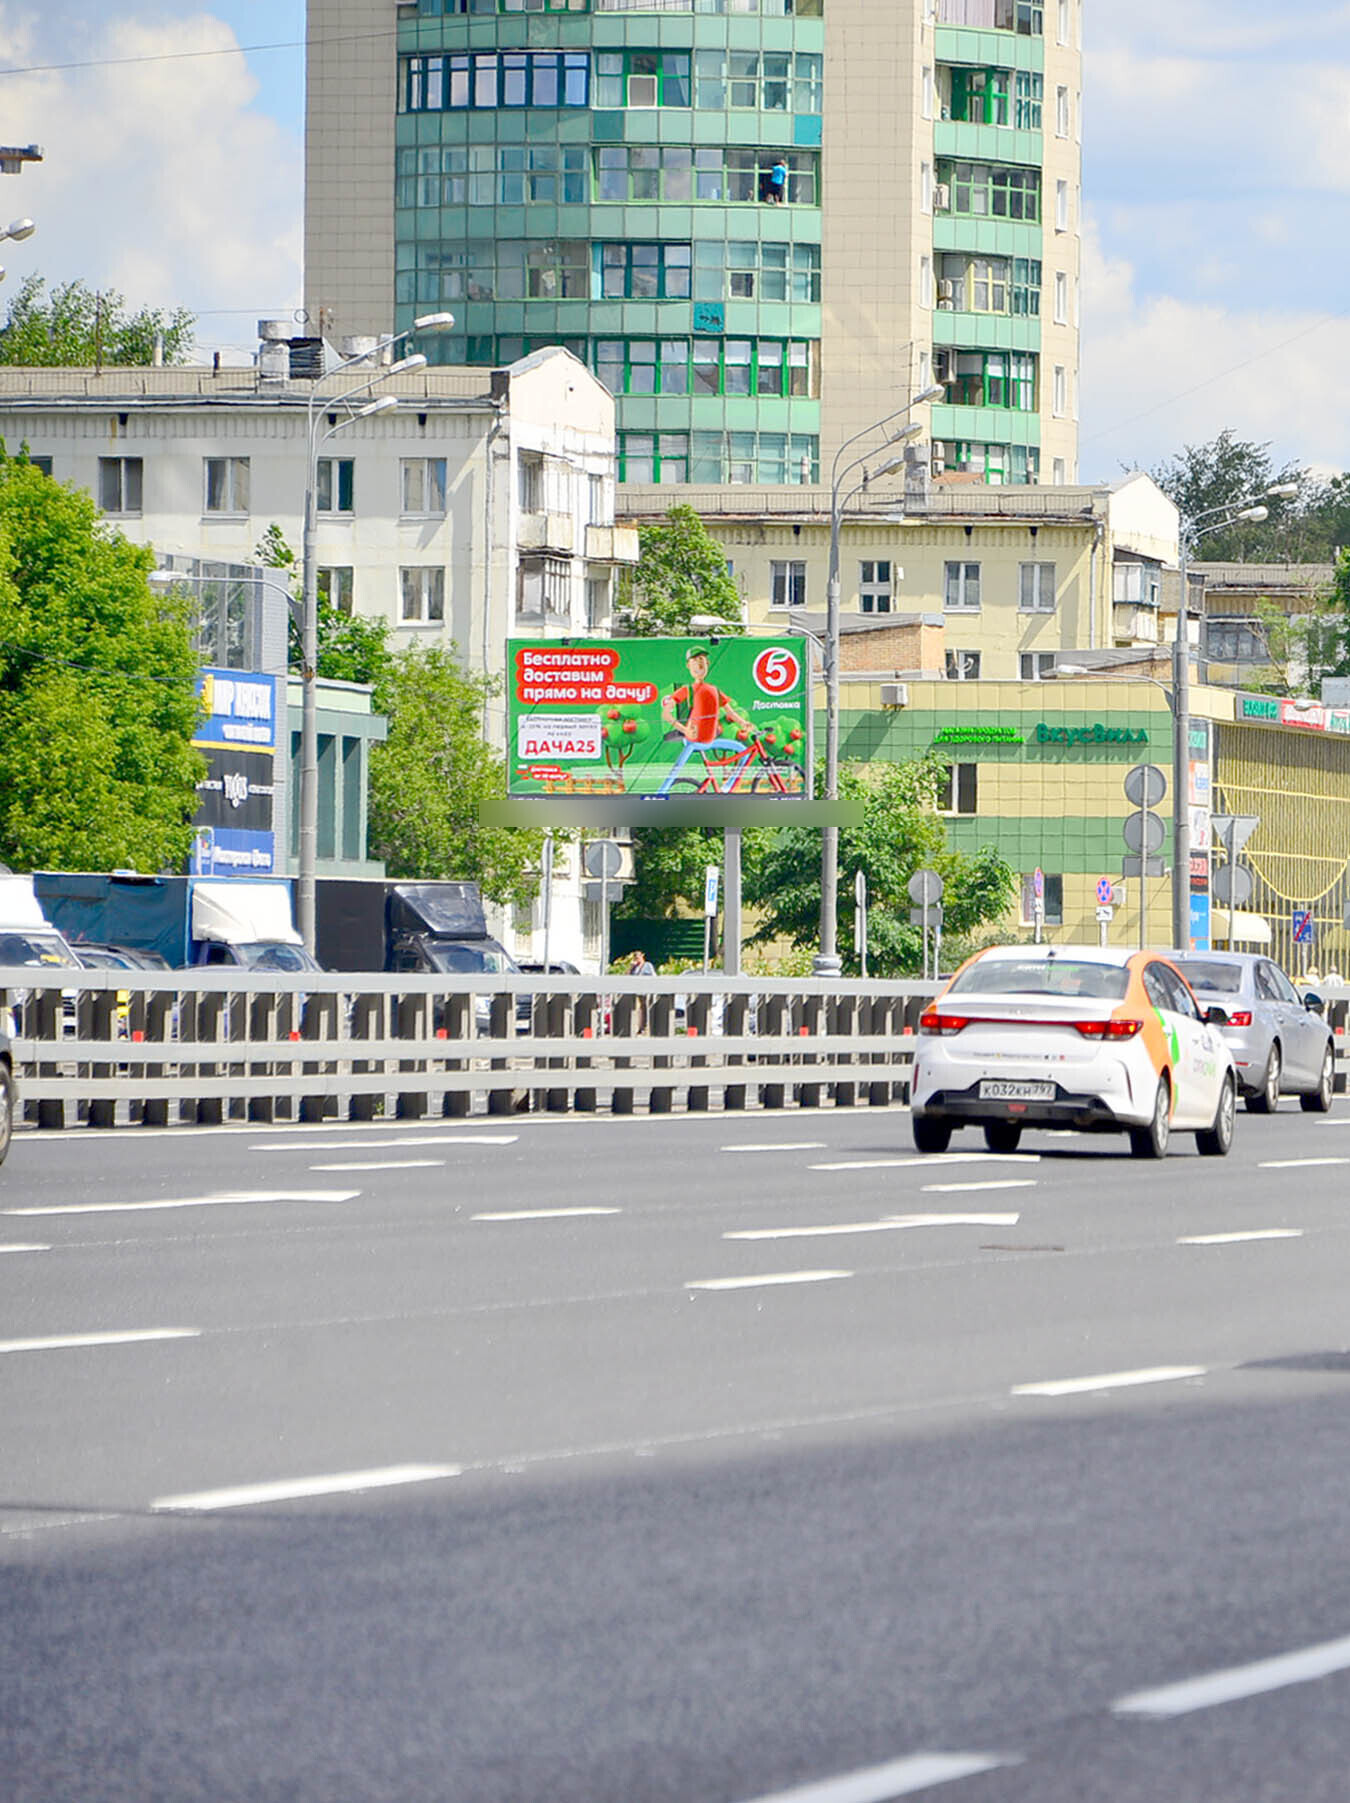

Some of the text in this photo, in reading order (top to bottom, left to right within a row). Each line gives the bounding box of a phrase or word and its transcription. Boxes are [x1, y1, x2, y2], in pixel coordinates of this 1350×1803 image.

[523, 652, 612, 666] Бесплатно
[523, 668, 605, 683] доставим
[765, 650, 790, 687] 5
[523, 684, 652, 702] прямо на дачу!
[524, 740, 596, 756] ДАЧА25
